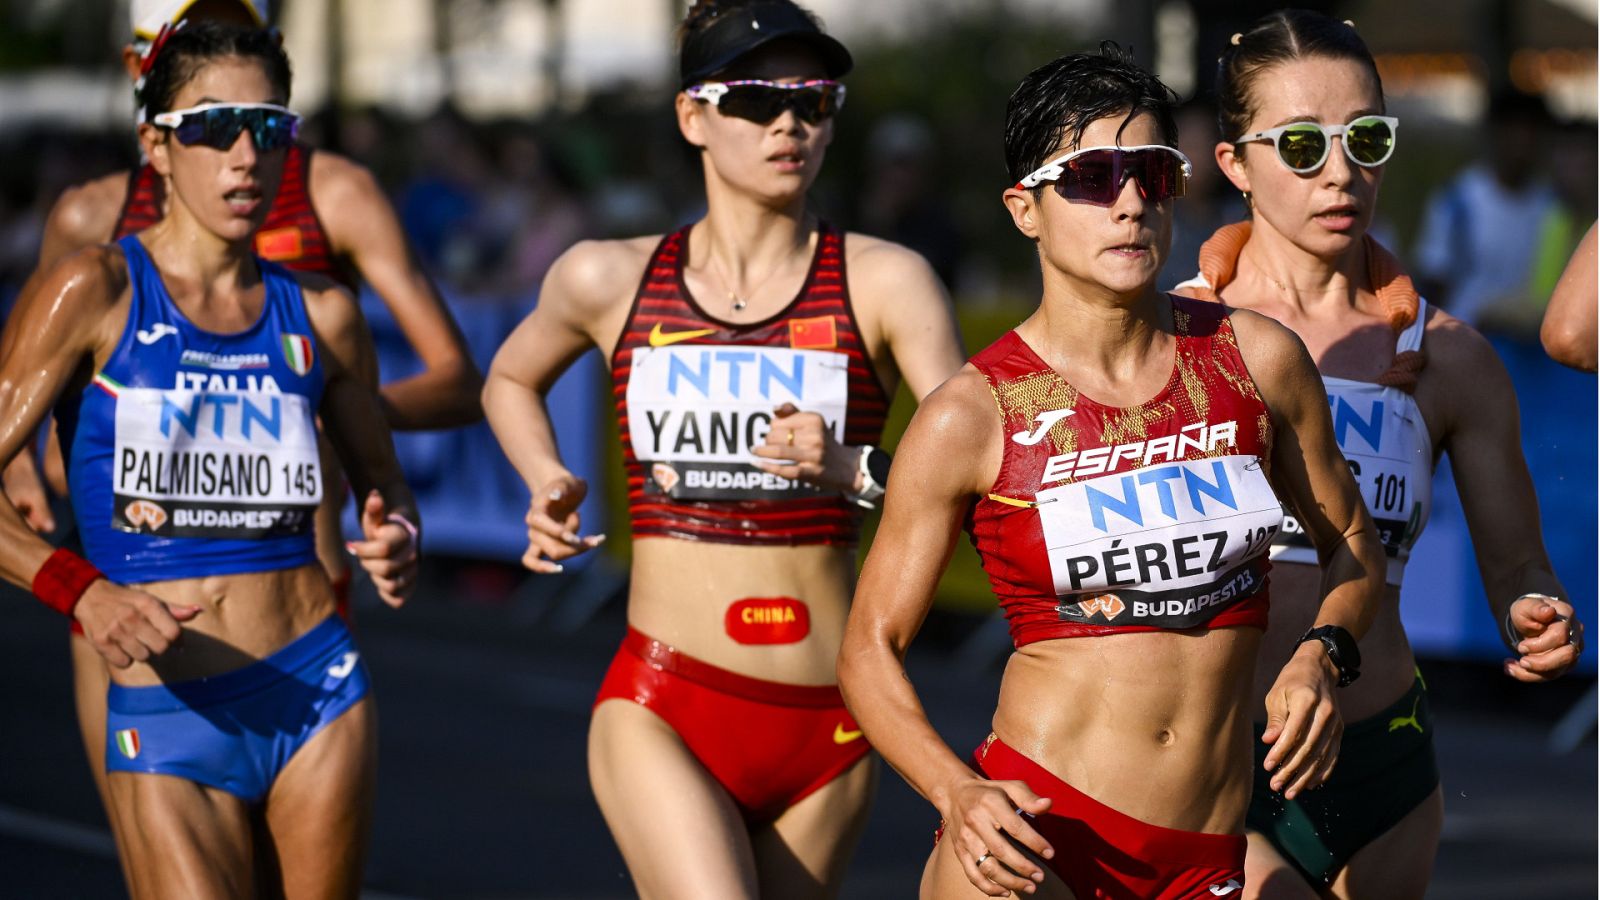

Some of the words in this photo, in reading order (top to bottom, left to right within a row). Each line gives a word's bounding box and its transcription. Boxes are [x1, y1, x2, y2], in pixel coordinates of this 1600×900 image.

[667, 351, 805, 401] NTN
[159, 393, 282, 442] NTN
[646, 410, 771, 455] YANG
[120, 447, 272, 496] PALMISANO
[282, 463, 316, 496] 145
[1040, 420, 1237, 484] ESPAÑA
[1085, 461, 1238, 533] NTN
[1374, 472, 1406, 513] 101
[1066, 530, 1228, 590] PÉREZ
[741, 606, 796, 624] CHINA
[1132, 581, 1237, 617] BUDAPEST
[1236, 569, 1254, 591] 23
